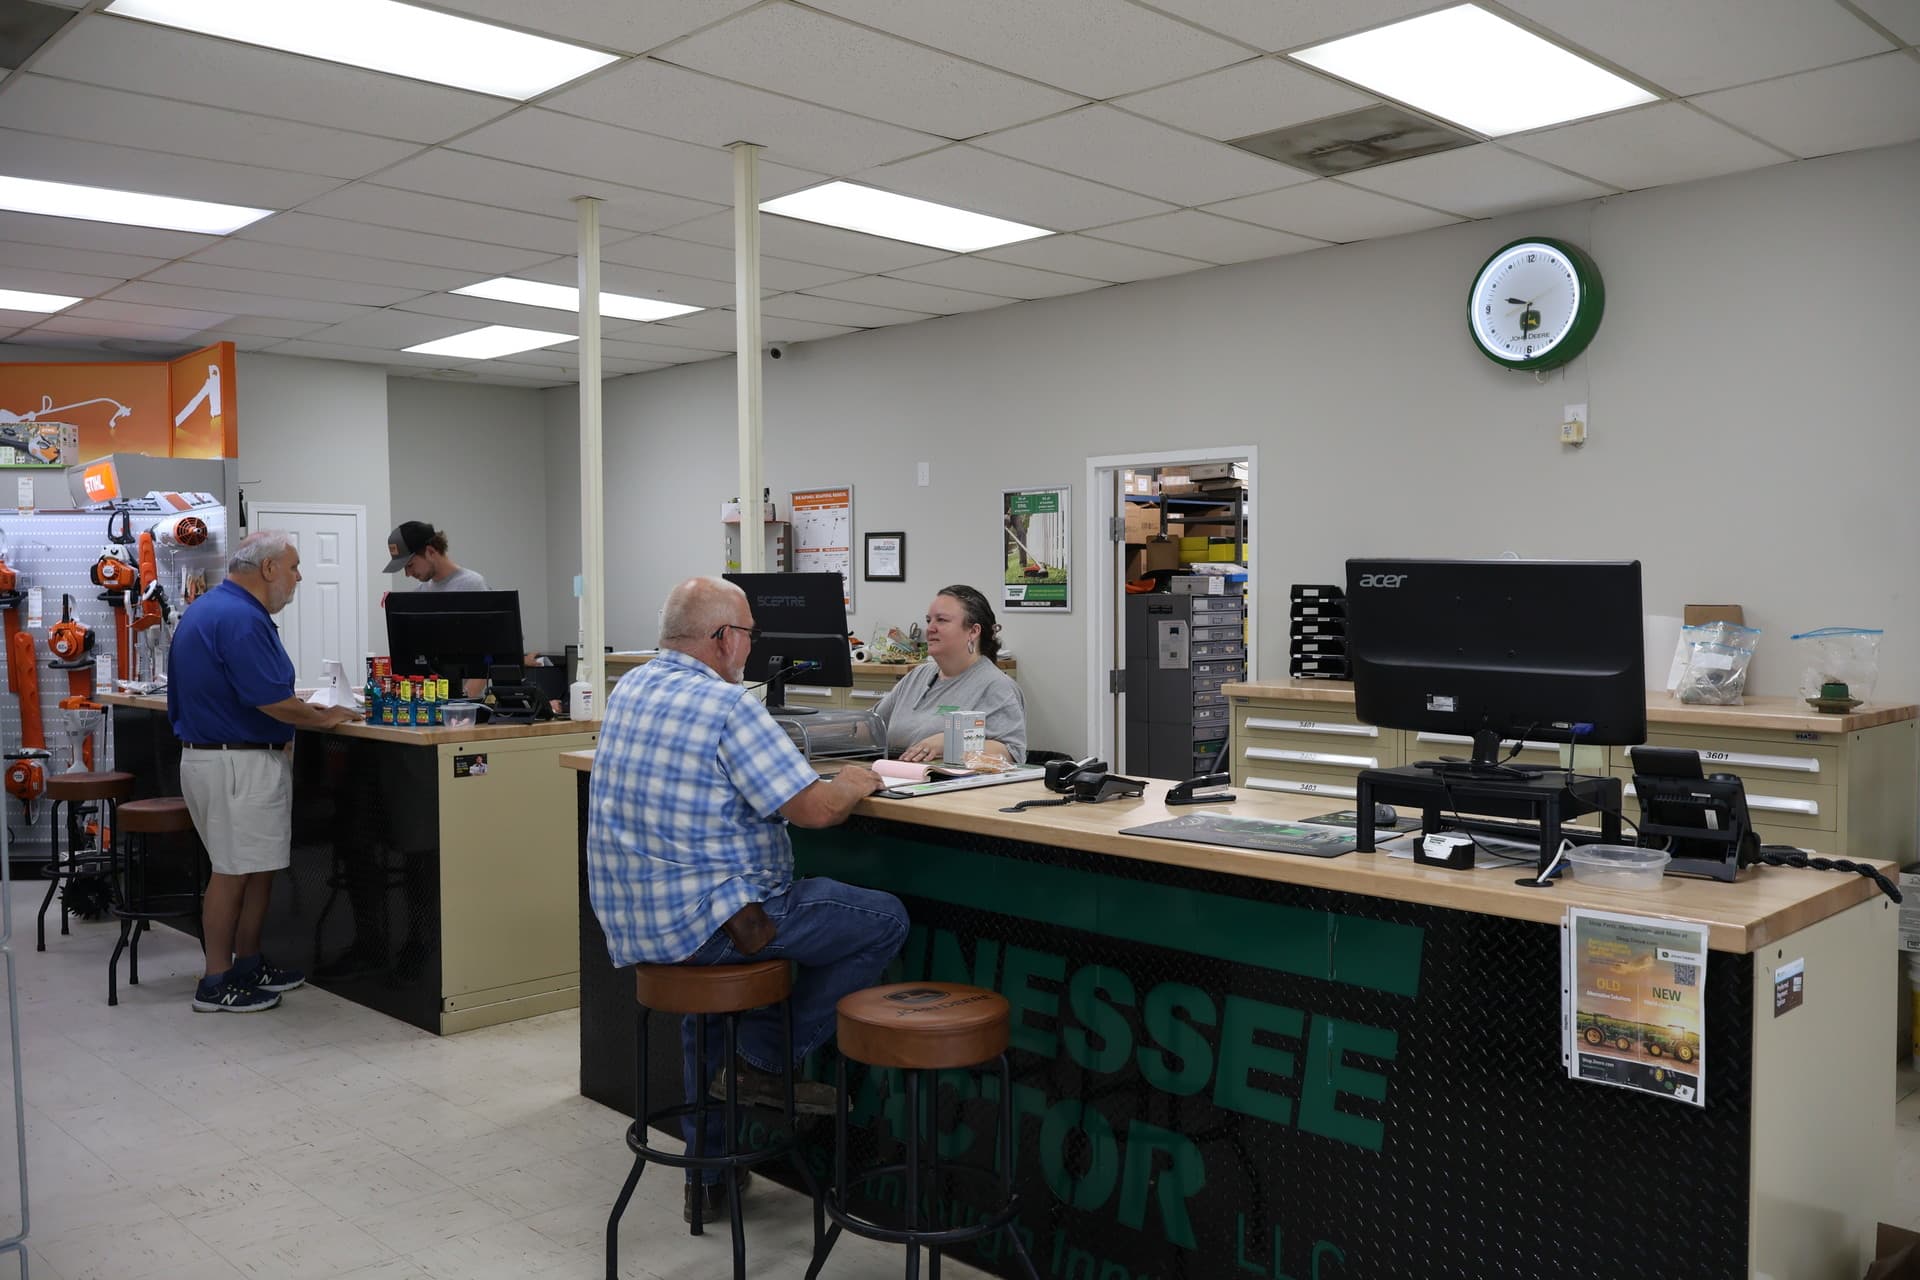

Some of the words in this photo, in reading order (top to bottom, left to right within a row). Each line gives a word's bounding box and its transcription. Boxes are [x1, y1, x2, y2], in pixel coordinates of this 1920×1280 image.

[1528, 254, 1536, 264] 12
[1485, 305, 1491, 315] 9
[1528, 332, 1549, 340] DEERE
[1526, 345, 1532, 354] 6
[84, 474, 105, 494] STIHL
[1360, 574, 1408, 588] acer
[757, 595, 806, 607] SCEPTRE
[1705, 751, 1729, 761] 3601
[1299, 783, 1317, 792] 3403
[1596, 977, 1621, 992] OLD
[1652, 986, 1682, 1002] NEW
